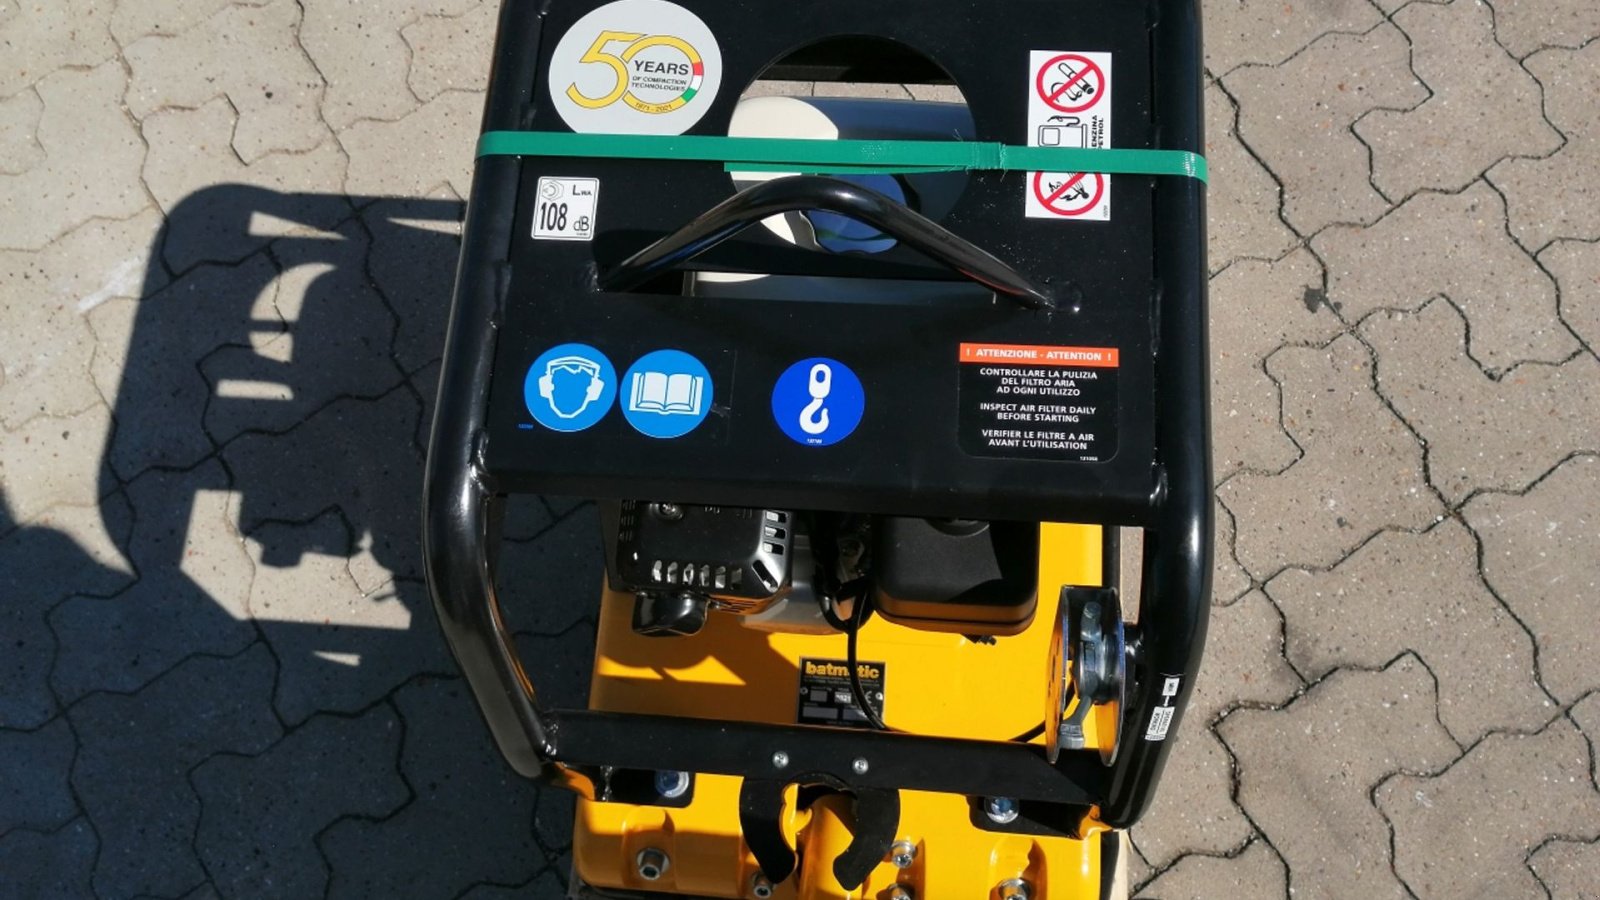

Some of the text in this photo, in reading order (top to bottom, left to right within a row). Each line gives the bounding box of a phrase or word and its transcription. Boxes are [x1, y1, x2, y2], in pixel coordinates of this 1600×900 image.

[566, 30, 704, 115] 50
[634, 60, 689, 75] YEARS
[643, 76, 687, 85] COMPACTION
[631, 82, 686, 91] TECHNOLOGIES
[656, 104, 672, 113] 2021
[540, 202, 568, 231] 108
[573, 216, 590, 231] dB
[976, 348, 1037, 359] ATTENZIONE
[1046, 350, 1102, 361] ATTENTION
[980, 368, 1098, 379] CONTROLLARE LA PULIZIA
[1021, 378, 1051, 386] FILTRO
[1053, 379, 1076, 387] ARIA
[996, 386, 1080, 396] AD OGNI UTILIZZO
[980, 403, 1097, 414] INSPECT AIR FILTER DAILY
[997, 413, 1079, 422] BEFORE STARTING
[981, 429, 1021, 438] VERIFIER
[1023, 431, 1034, 439] LE
[1037, 431, 1066, 440] FILTRE
[1078, 433, 1094, 441] AIR
[988, 439, 1087, 449] AVANT L'UTILISATION
[805, 661, 880, 679] batmtic
